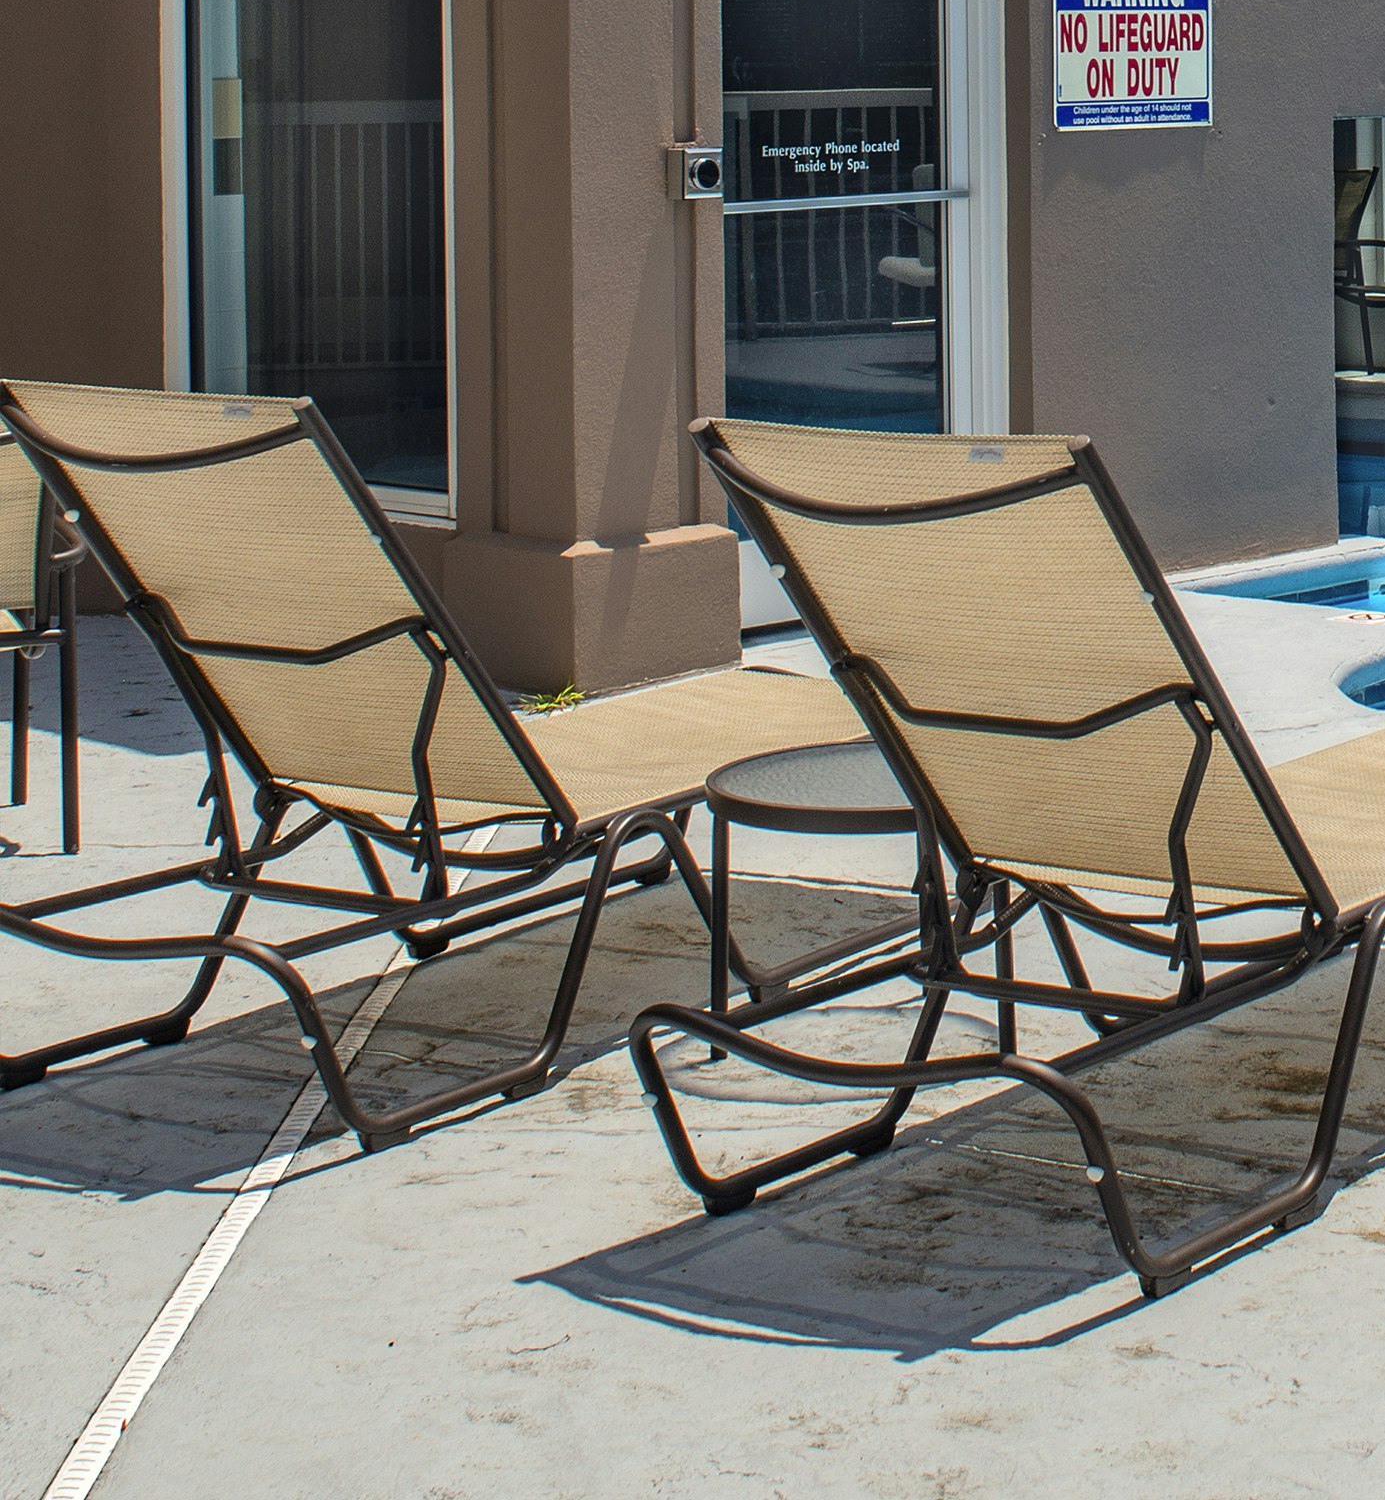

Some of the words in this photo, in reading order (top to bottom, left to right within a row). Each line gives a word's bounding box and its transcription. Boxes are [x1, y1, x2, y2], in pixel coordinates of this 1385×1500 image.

[1060, 13, 1088, 53] NO
[1098, 13, 1204, 52] LIFEGUARD
[1086, 58, 1114, 99] ON
[1127, 57, 1180, 97] DUTY
[1073, 106, 1100, 114] Children
[1101, 106, 1120, 114] under
[1120, 105, 1130, 113] the
[1131, 106, 1142, 114] age
[1144, 104, 1151, 112] of
[1152, 104, 1159, 112] 14
[1160, 103, 1180, 111] should
[1181, 103, 1192, 111] not
[1086, 116, 1100, 125] pool
[1101, 115, 1124, 123] without
[1134, 114, 1150, 122] adult
[1151, 113, 1156, 121] in
[1157, 113, 1192, 121] attendance.
[762, 145, 821, 160] Emergency
[825, 142, 858, 155] Phone
[861, 139, 900, 153] located
[795, 160, 827, 173] inside
[830, 158, 844, 174] by
[847, 158, 870, 173] Spa.
